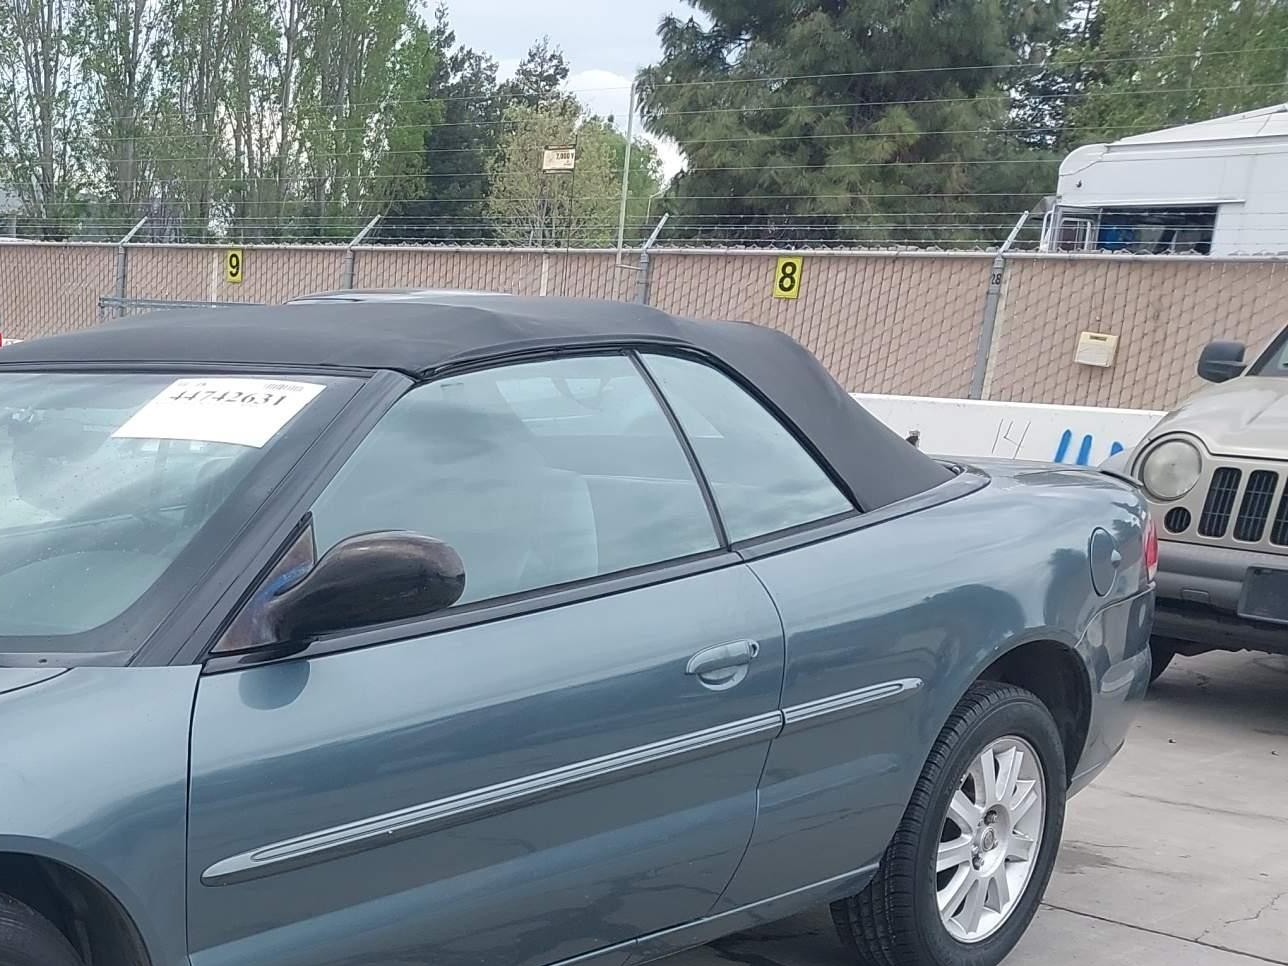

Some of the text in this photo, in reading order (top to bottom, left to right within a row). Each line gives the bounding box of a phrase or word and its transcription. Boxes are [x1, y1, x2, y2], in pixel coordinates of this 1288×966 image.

[229, 253, 240, 277] 9
[778, 261, 797, 292] 8
[991, 273, 1002, 285] 28
[169, 390, 287, 406] 44742631
